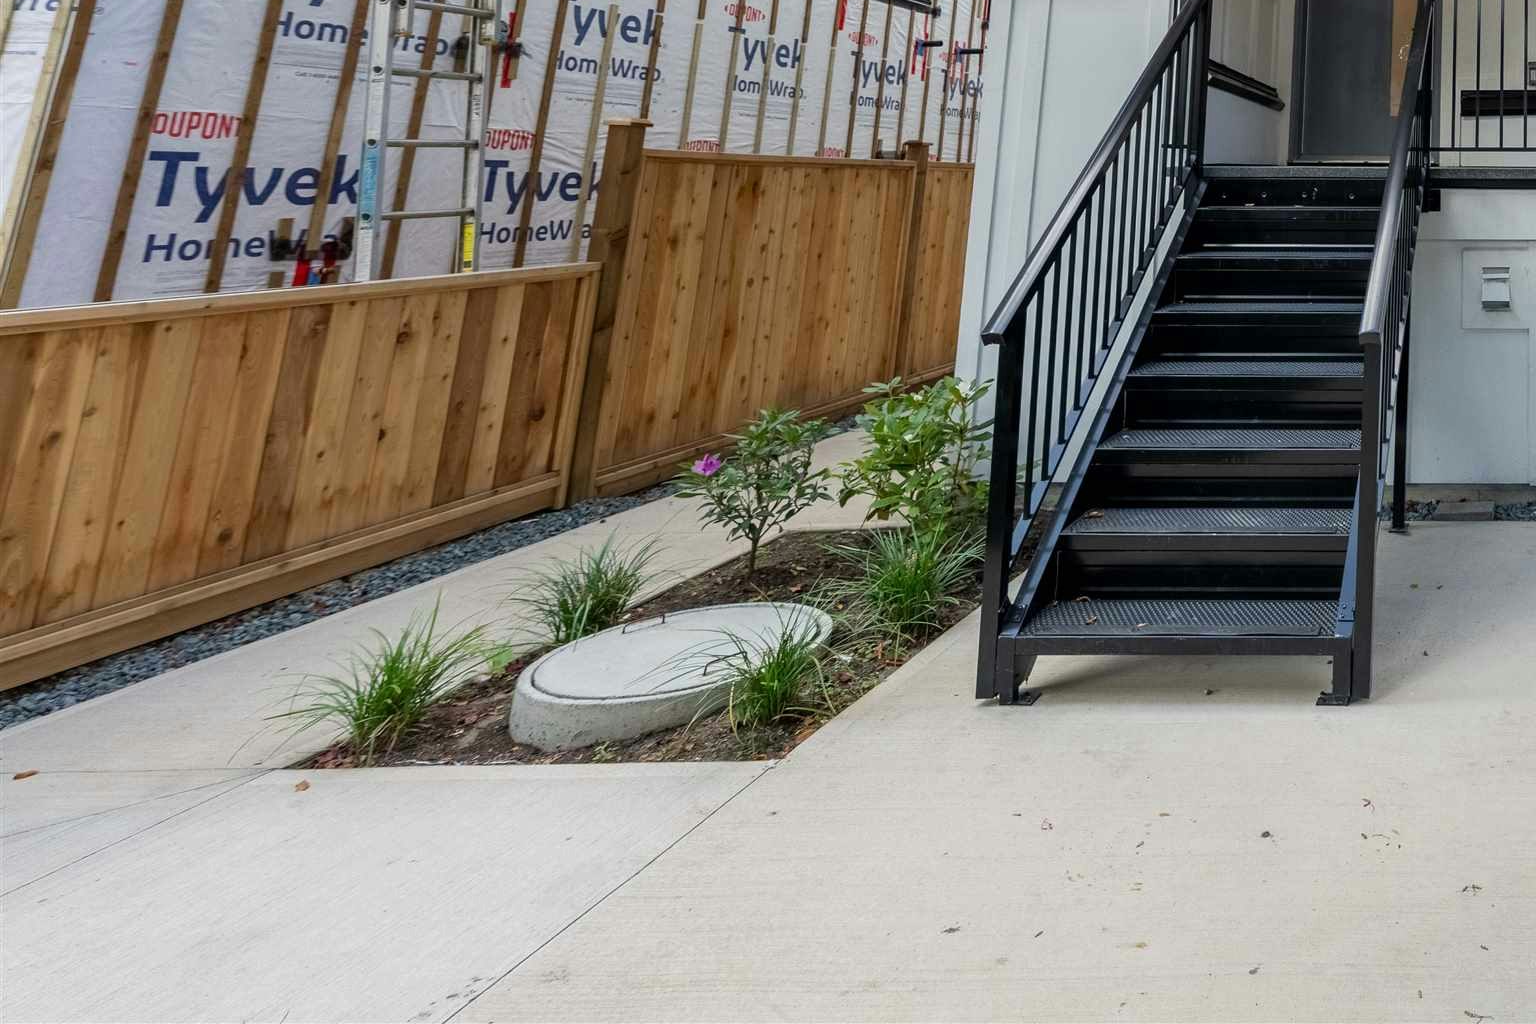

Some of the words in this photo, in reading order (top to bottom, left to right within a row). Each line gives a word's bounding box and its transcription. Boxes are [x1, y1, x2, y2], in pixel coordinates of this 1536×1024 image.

[729, 4, 761, 22] DONT
[557, 50, 660, 81] HomWrap
[733, 75, 803, 98] omWrap
[151, 112, 241, 139] DUPONT
[485, 129, 535, 150] DUPONT
[149, 151, 359, 222] Tyvek
[484, 160, 602, 214] Tyvek
[480, 219, 592, 244] HomeWa
